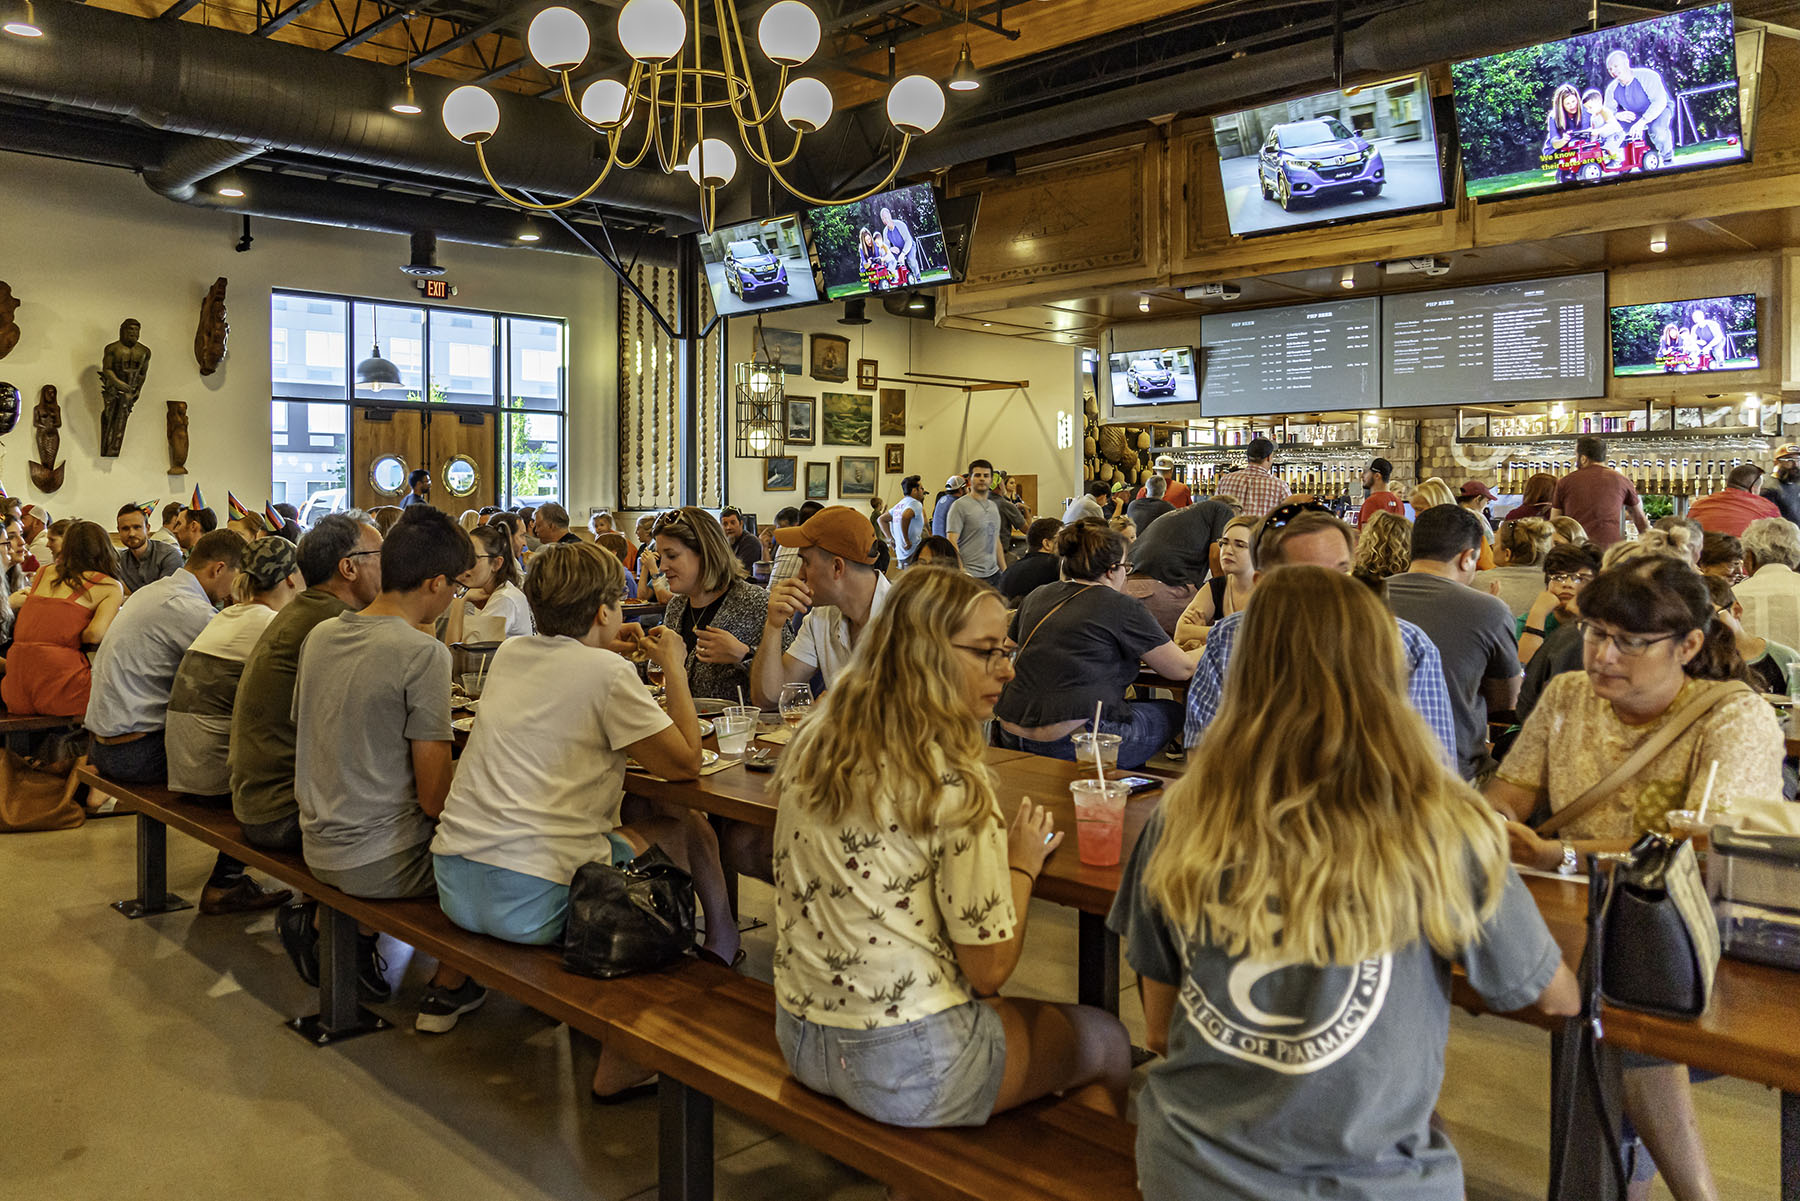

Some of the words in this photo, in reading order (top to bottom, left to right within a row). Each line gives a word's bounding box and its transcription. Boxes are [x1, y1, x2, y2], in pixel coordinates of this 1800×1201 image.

[1539, 154, 1553, 162] We
[1554, 151, 1576, 159] know
[1541, 162, 1559, 171] their
[427, 280, 446, 297] EXIT
[1239, 1037, 1269, 1057] OF
[1276, 997, 1369, 1064] PHARMACY
